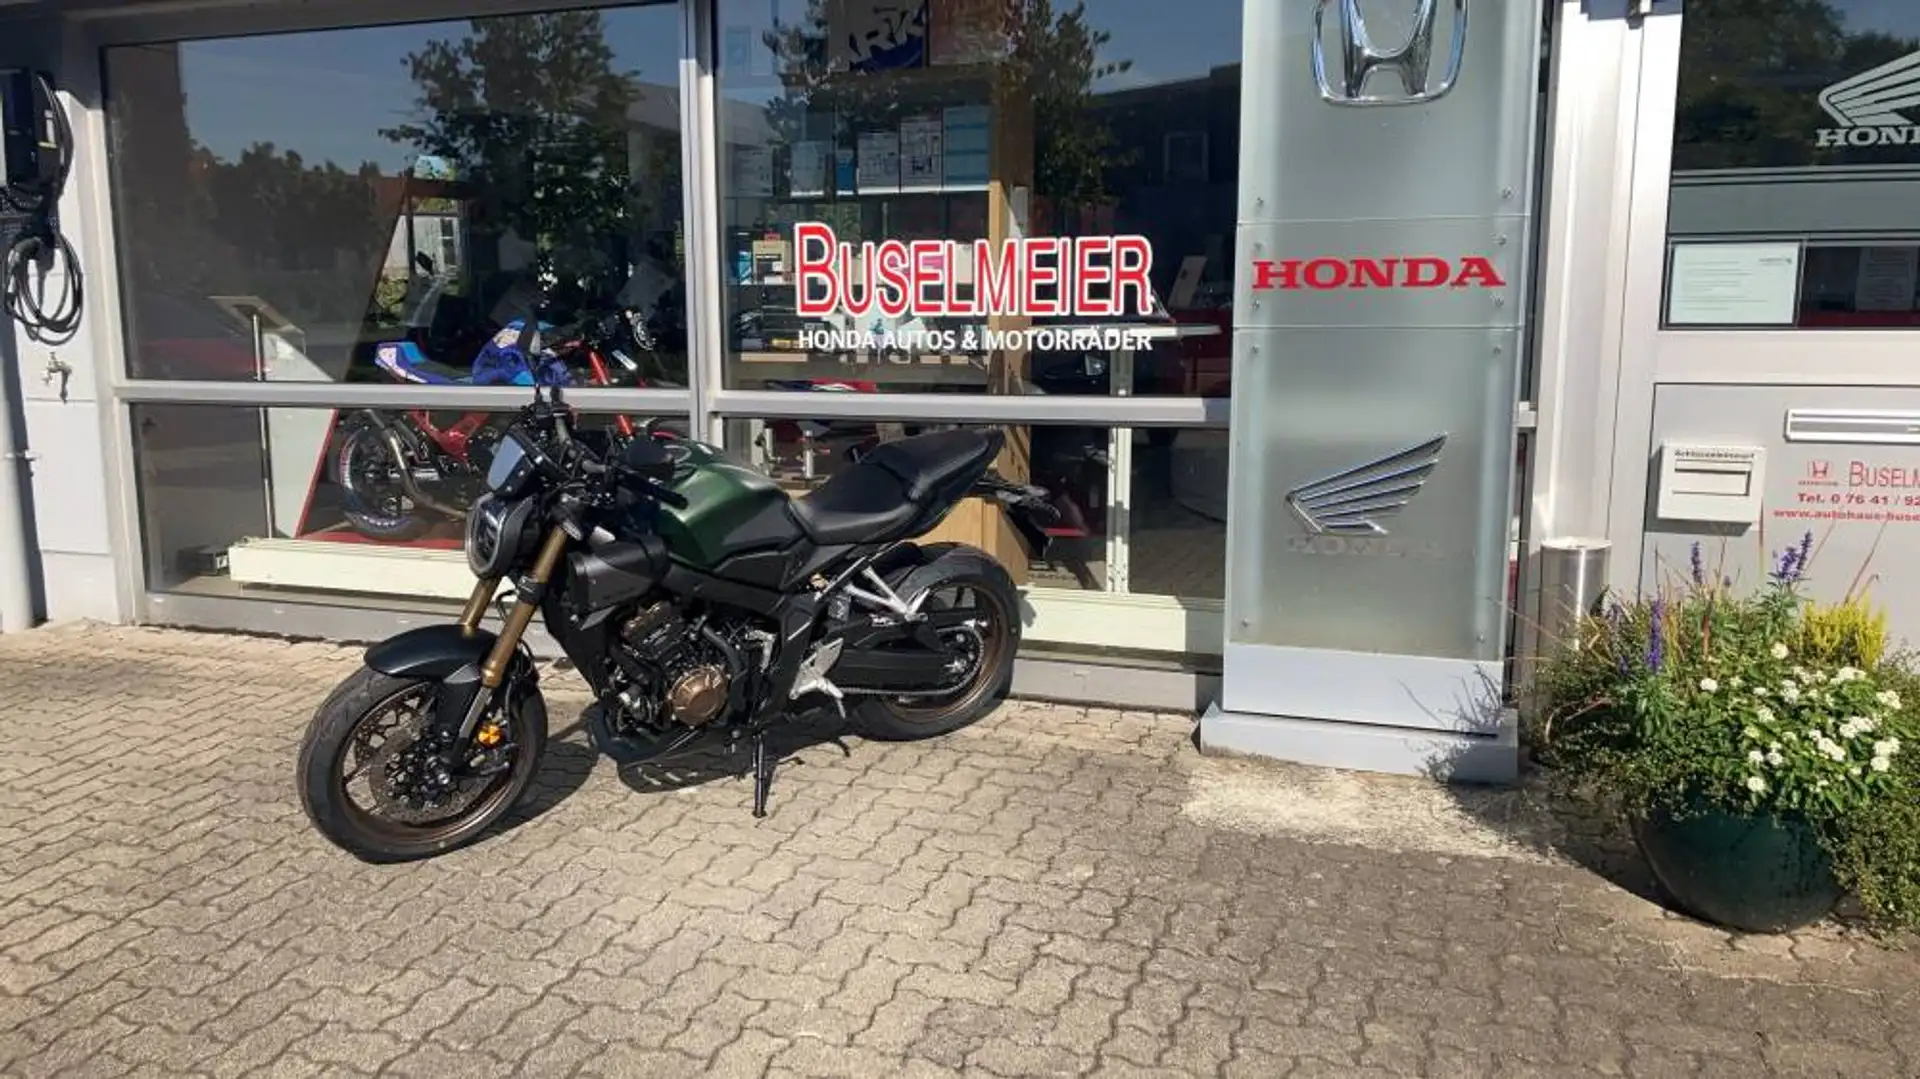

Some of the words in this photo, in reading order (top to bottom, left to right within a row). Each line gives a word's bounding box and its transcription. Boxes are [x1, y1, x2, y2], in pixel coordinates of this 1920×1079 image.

[795, 222, 1153, 317] BUSELMEIER
[1252, 257, 1506, 290] HONDA
[798, 329, 876, 350] HONDA
[884, 329, 956, 350] AUTOS
[960, 329, 980, 350] &
[985, 324, 1153, 350] MOTORRÄDER
[1798, 492, 1825, 503] Tel.
[1845, 494, 1865, 504] 76
[1868, 495, 1889, 505] 41
